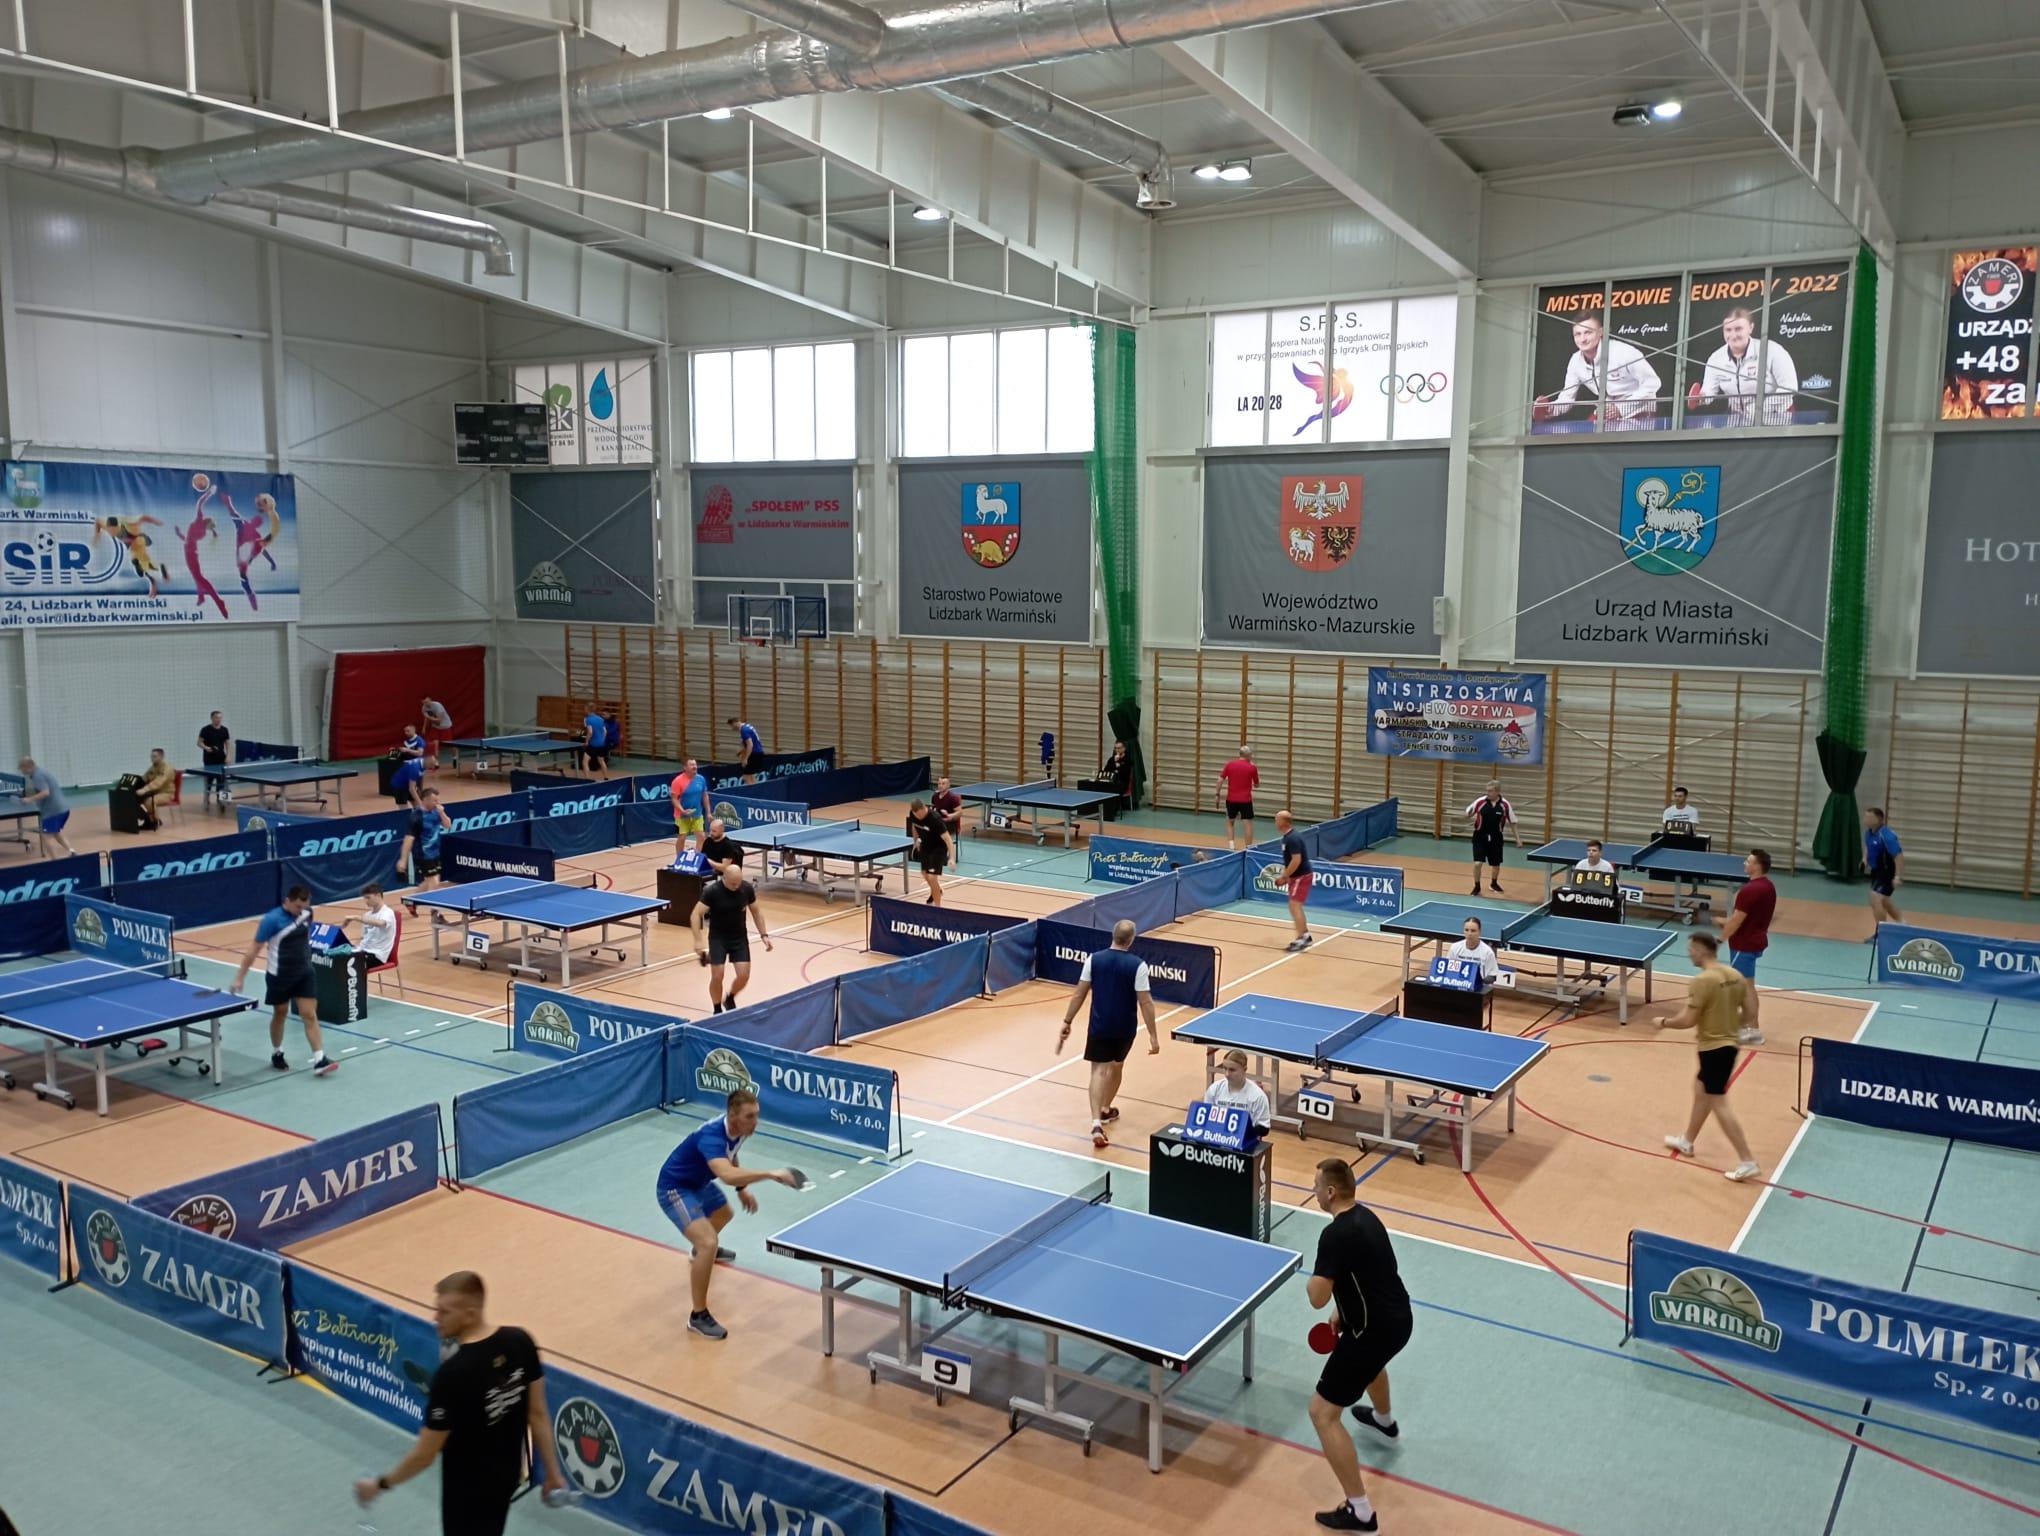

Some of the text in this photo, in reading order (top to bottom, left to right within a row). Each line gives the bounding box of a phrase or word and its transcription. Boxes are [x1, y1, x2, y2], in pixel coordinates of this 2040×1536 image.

[1968, 262, 2018, 286] ZAMER
[1546, 287, 1673, 312] MISTRZOWIE
[1786, 273, 1840, 294] 2022
[1780, 311, 1812, 322] Natalia
[1338, 332, 1390, 344] Bogdanowicz
[1340, 343, 1369, 355] Igrzysk
[1956, 345, 2020, 373] +48
[1237, 395, 1282, 411] LA 2028
[815, 500, 840, 512] PSS
[1965, 538, 2040, 562] HOT
[5, 601, 27, 613] 24,
[31, 599, 92, 611] Lidzbark
[923, 586, 1063, 604] Starostwo Powiatowe
[1262, 592, 1378, 612] Województwo
[929, 606, 1057, 624] Lidzbark Warmiński
[1595, 598, 1733, 621] Urząd Miasta
[1229, 614, 1416, 635] Warmińsko-Mazurskie
[1562, 623, 1769, 646] Lidzbark Warmiński
[1377, 681, 1534, 703] MISTRZOSTWA
[550, 793, 619, 817] andro
[747, 807, 804, 825] POLMLEK
[300, 829, 393, 857] andro
[137, 852, 246, 881] andro
[456, 854, 539, 876] LIDZBARK WARMIŃSKI
[771, 866, 780, 876] 7
[0, 879, 74, 904] dro
[1312, 872, 1395, 895] POLMLEK
[1604, 875, 1611, 887] 5
[1575, 893, 1615, 908] Butterfly
[112, 917, 167, 948] POLMLEK
[891, 919, 942, 941] LIDZBARK
[472, 938, 484, 950] 6
[1146, 961, 1187, 982] MIŃSKI
[1437, 960, 1446, 974] 9
[1461, 964, 1470, 978] 4
[770, 1064, 885, 1111] POLMLEK
[1841, 1078, 1939, 1110] LIDZBARK
[830, 1108, 852, 1126] Sp.
[1301, 1097, 1330, 1117] 10
[1195, 1106, 1207, 1126] 6
[1227, 1113, 1239, 1132] 6
[1203, 1130, 1240, 1147] Butterfly
[1184, 1145, 1245, 1173] Butterfly
[258, 1139, 418, 1230] ZAMER
[177, 1200, 229, 1225] AMER
[140, 1245, 265, 1330] ZAMER
[1807, 1298, 2040, 1382] POLMLEK
[338, 1348, 364, 1371] tenis
[933, 1358, 958, 1386] 9
[1933, 1370, 1973, 1397] Sp.
[1980, 1384, 1995, 1401] z
